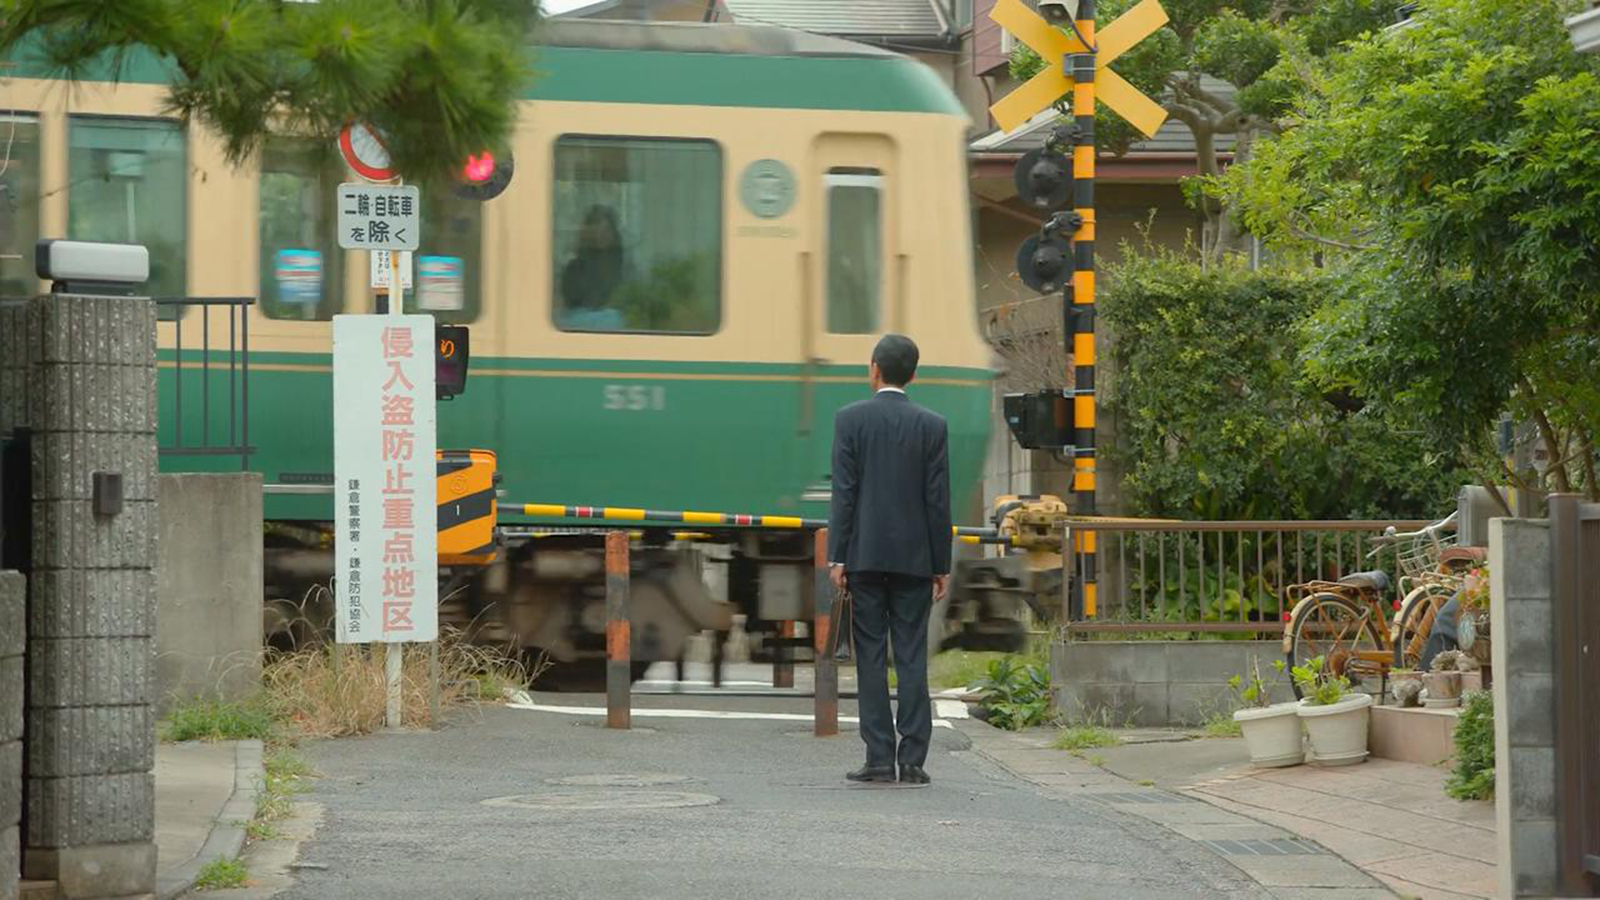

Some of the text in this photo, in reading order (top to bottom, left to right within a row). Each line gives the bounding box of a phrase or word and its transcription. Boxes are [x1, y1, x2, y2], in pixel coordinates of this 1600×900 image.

[351, 221, 407, 243] を除く
[602, 384, 665, 410] 551
[381, 326, 415, 632] 侵入盗防止重点地区
